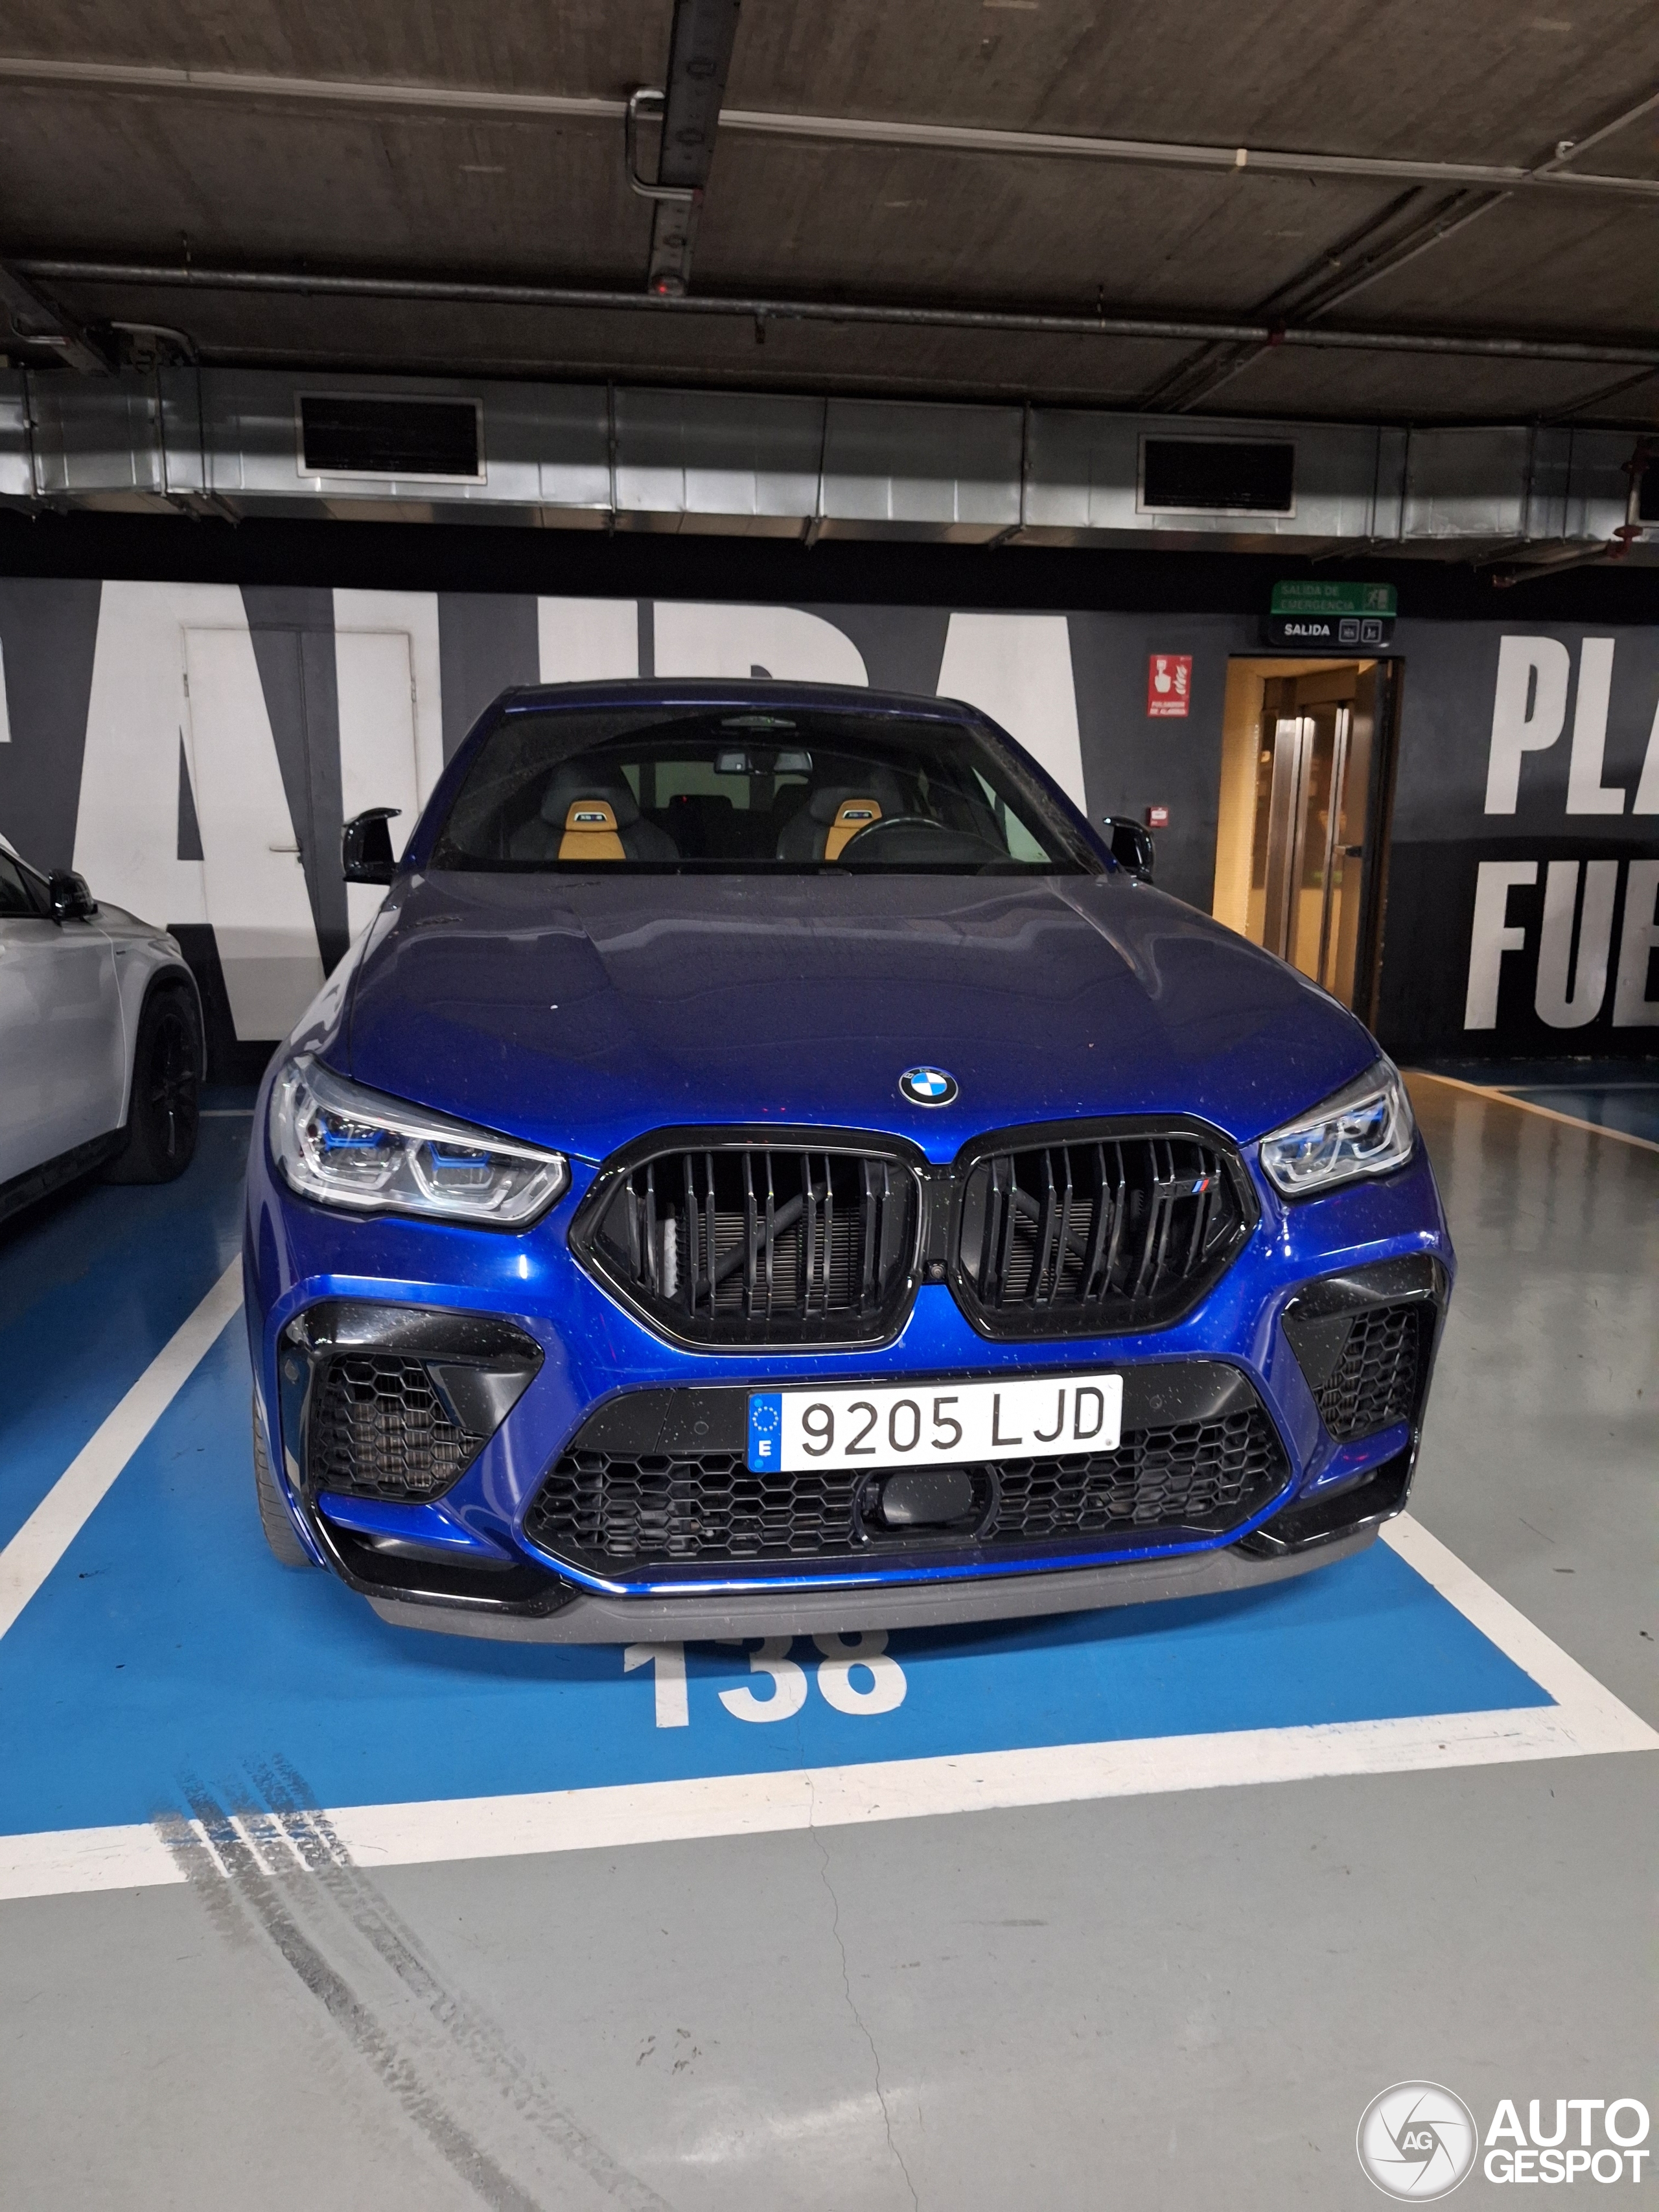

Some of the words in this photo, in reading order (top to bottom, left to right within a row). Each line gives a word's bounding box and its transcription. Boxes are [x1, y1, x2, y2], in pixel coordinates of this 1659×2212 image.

[1281, 586, 1321, 595] SALIDA
[1284, 623, 1330, 636] SALIDA
[801, 1396, 963, 1457] 9205
[992, 1386, 1105, 1447] LJD
[758, 1439, 772, 1456] E
[624, 1629, 907, 1729] 138
